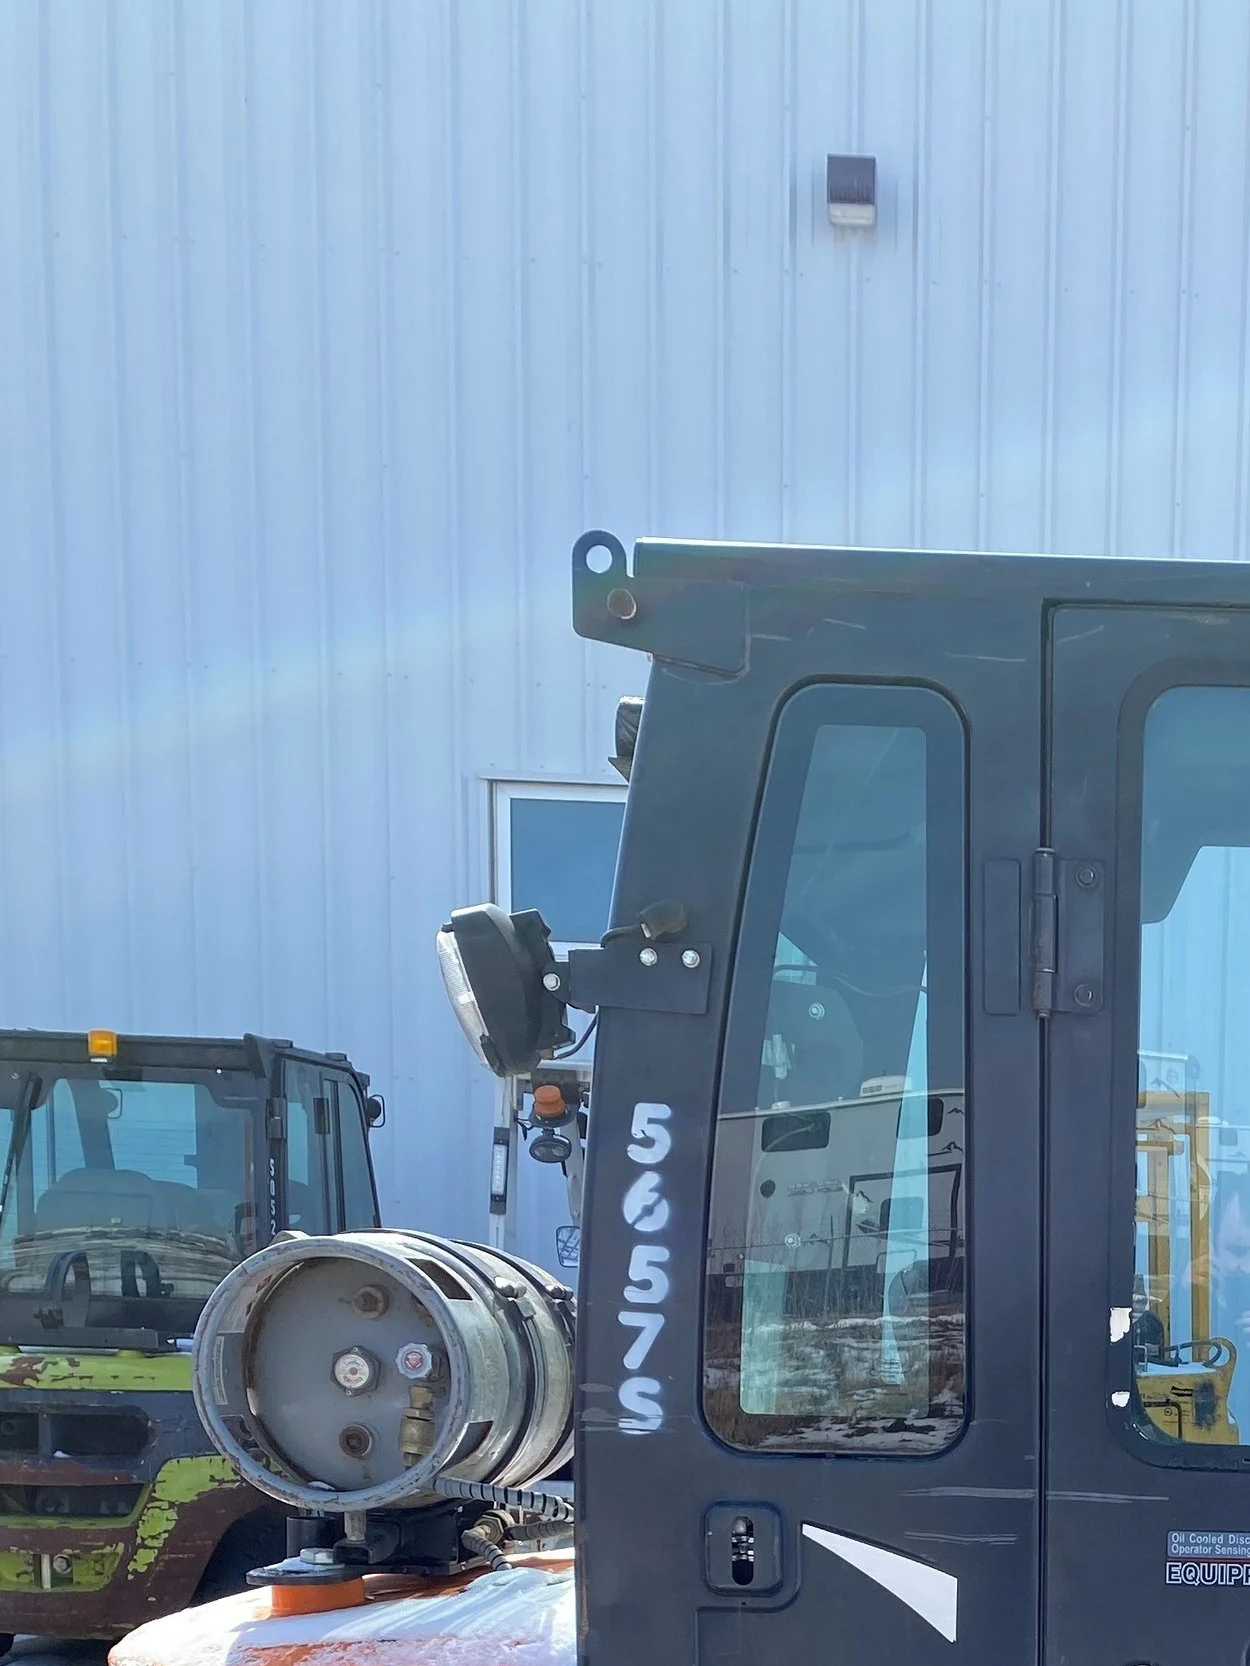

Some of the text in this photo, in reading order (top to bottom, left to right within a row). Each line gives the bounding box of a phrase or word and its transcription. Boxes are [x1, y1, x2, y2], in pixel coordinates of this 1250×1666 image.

[1171, 1533, 1185, 1544] Oil
[1189, 1533, 1224, 1545] Cooled
[1228, 1534, 1250, 1545] Disc
[1171, 1544, 1213, 1556] Operator
